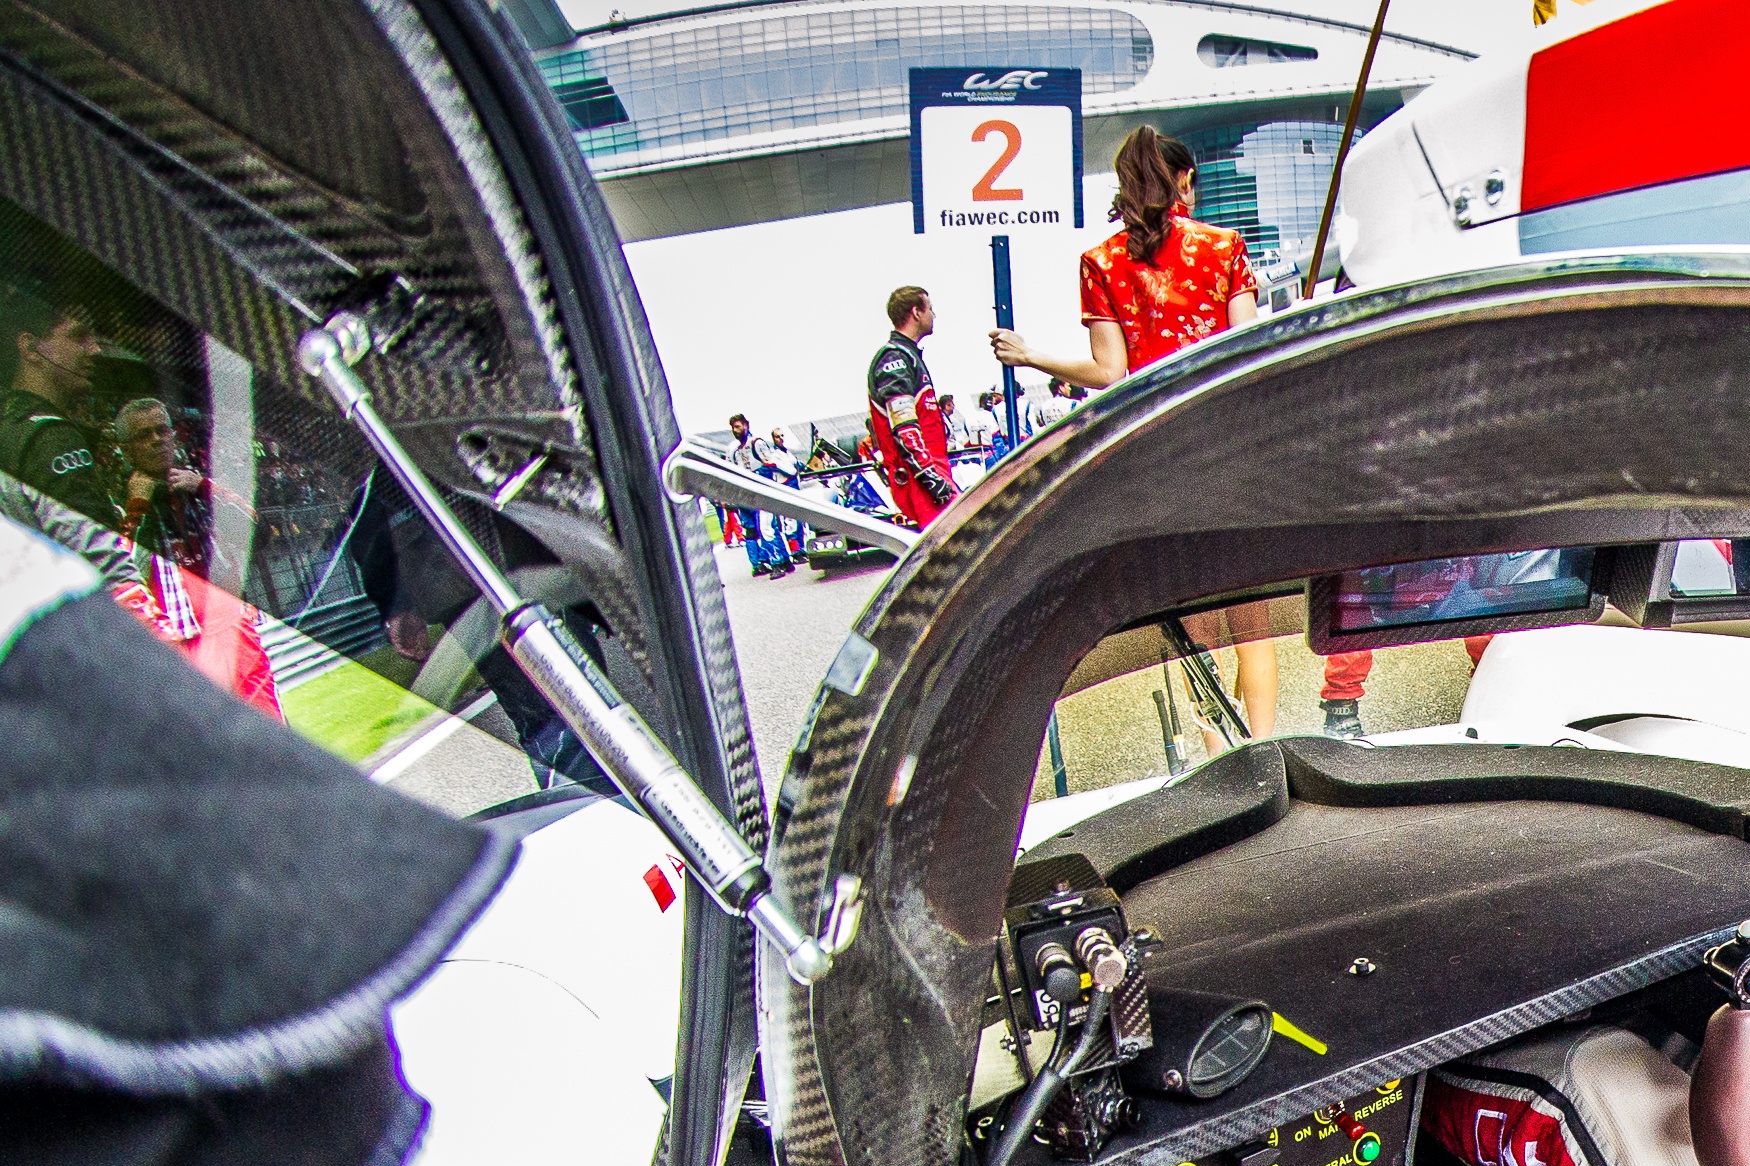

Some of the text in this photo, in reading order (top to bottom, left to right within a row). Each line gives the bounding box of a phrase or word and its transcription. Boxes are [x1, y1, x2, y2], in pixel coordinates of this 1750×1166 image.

[963, 71, 1048, 90] WEC
[972, 119, 1023, 201] 2
[941, 210, 1059, 226] fiawec.com
[1354, 1089, 1404, 1122] REVERSE
[1294, 1126, 1312, 1142] ON
